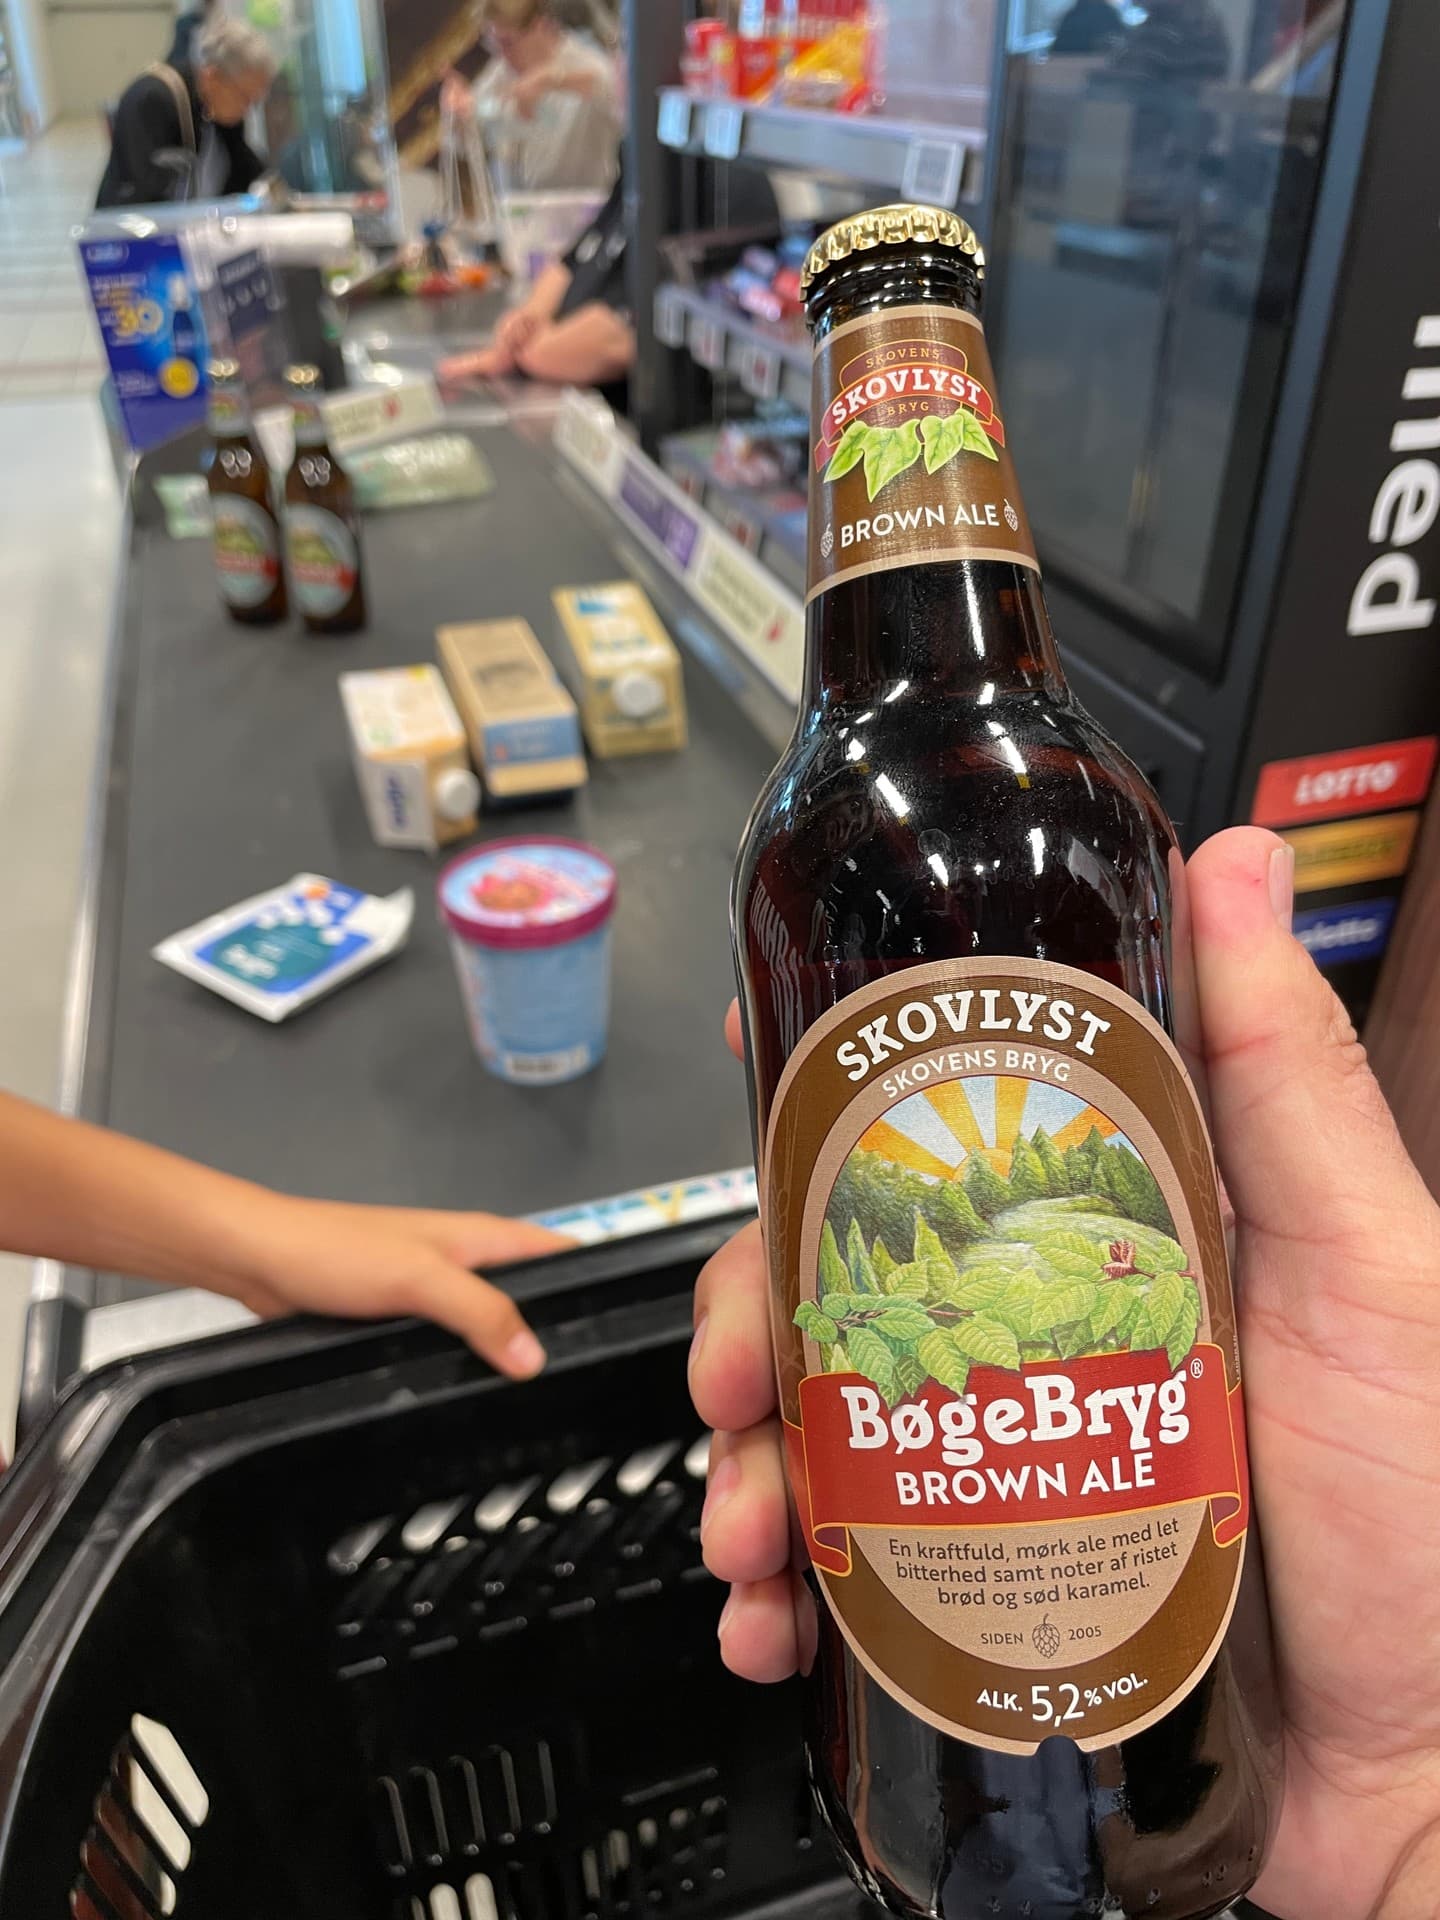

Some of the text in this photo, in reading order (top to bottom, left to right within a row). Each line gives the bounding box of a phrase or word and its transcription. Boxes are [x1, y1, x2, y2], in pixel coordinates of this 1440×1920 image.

[865, 347, 940, 369] SKOVENS
[831, 368, 982, 425] SKOVLYST
[886, 401, 930, 417] BRYG
[840, 504, 1000, 548] BROWN ALE
[1295, 761, 1397, 805] LOTTO
[836, 989, 1111, 1082] SKOVLYST
[882, 1049, 1071, 1098] SKOVENS BRYG
[895, 1452, 1156, 1505] BROWN ALE
[888, 1518, 1180, 1563] En kraftfuld, mørk ale med let
[896, 1542, 1179, 1583] bitterhed samt noter af ristet
[938, 1572, 1151, 1610] brød og sød karamel.
[980, 1625, 1103, 1645] SIDEN 2005
[976, 1688, 1024, 1712] ALK.
[1102, 1672, 1149, 1700] VOL.
